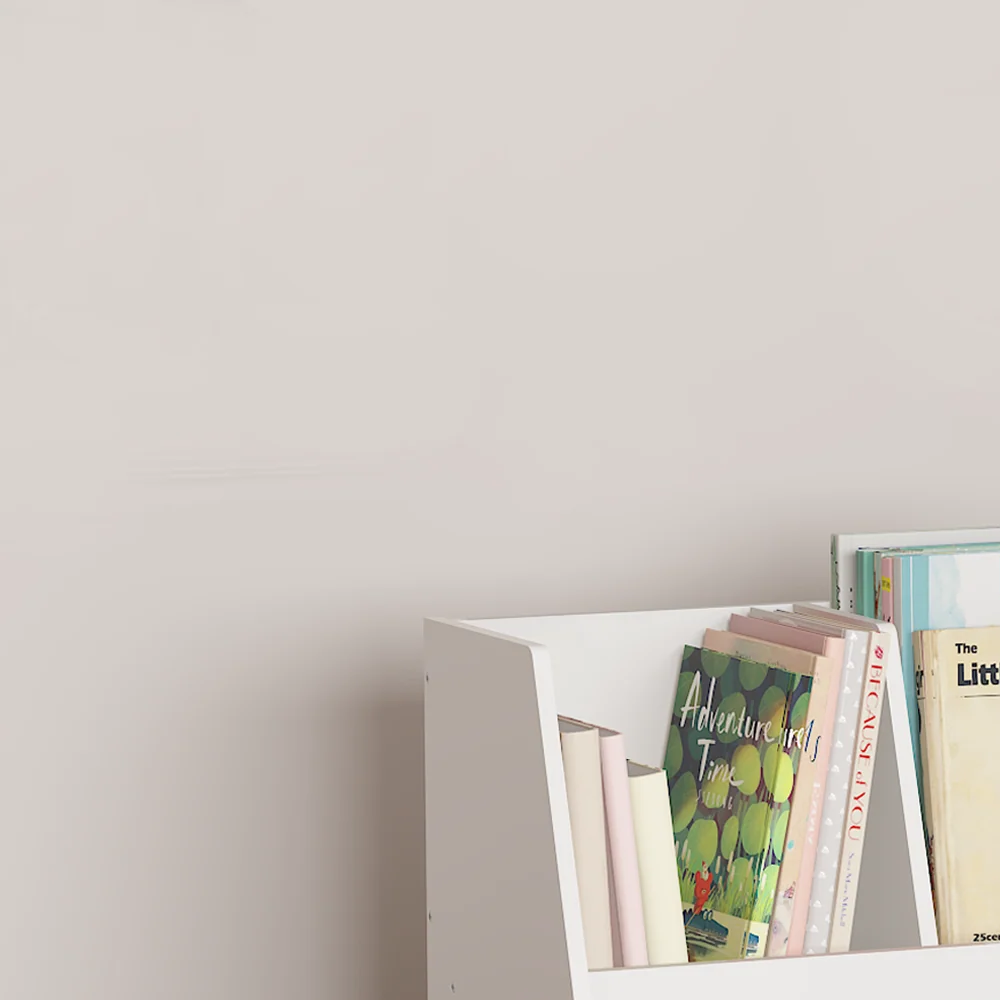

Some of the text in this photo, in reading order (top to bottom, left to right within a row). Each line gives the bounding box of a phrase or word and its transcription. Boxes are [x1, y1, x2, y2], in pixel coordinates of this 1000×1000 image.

[955, 643, 978, 654] The
[680, 670, 775, 743] Adventure
[857, 664, 882, 767] BECAUSE
[697, 738, 745, 786] Time
[848, 792, 866, 841] YOU
